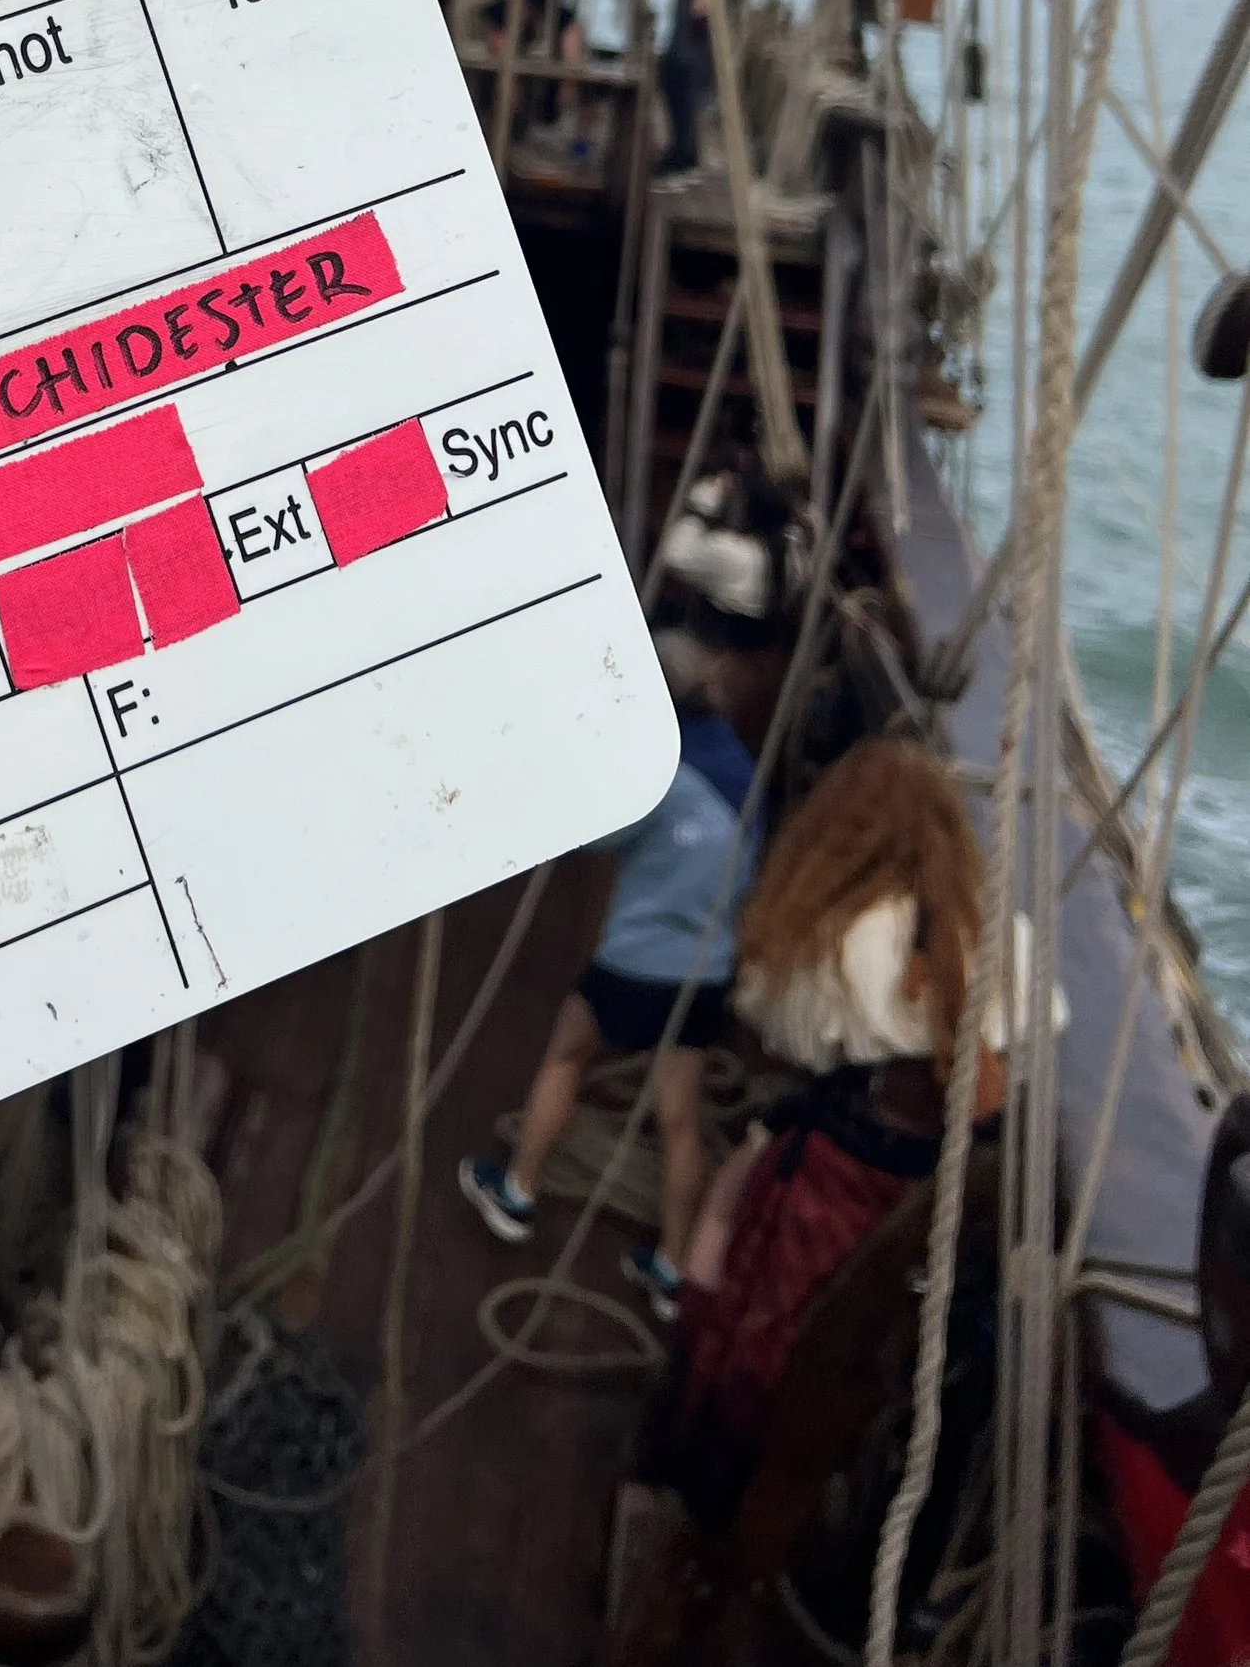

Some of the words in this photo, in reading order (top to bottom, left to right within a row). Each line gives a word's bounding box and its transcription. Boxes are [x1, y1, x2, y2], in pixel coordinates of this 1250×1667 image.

[442, 404, 555, 483] Sync
[228, 494, 312, 564] Ext
[106, 680, 160, 738] F:
